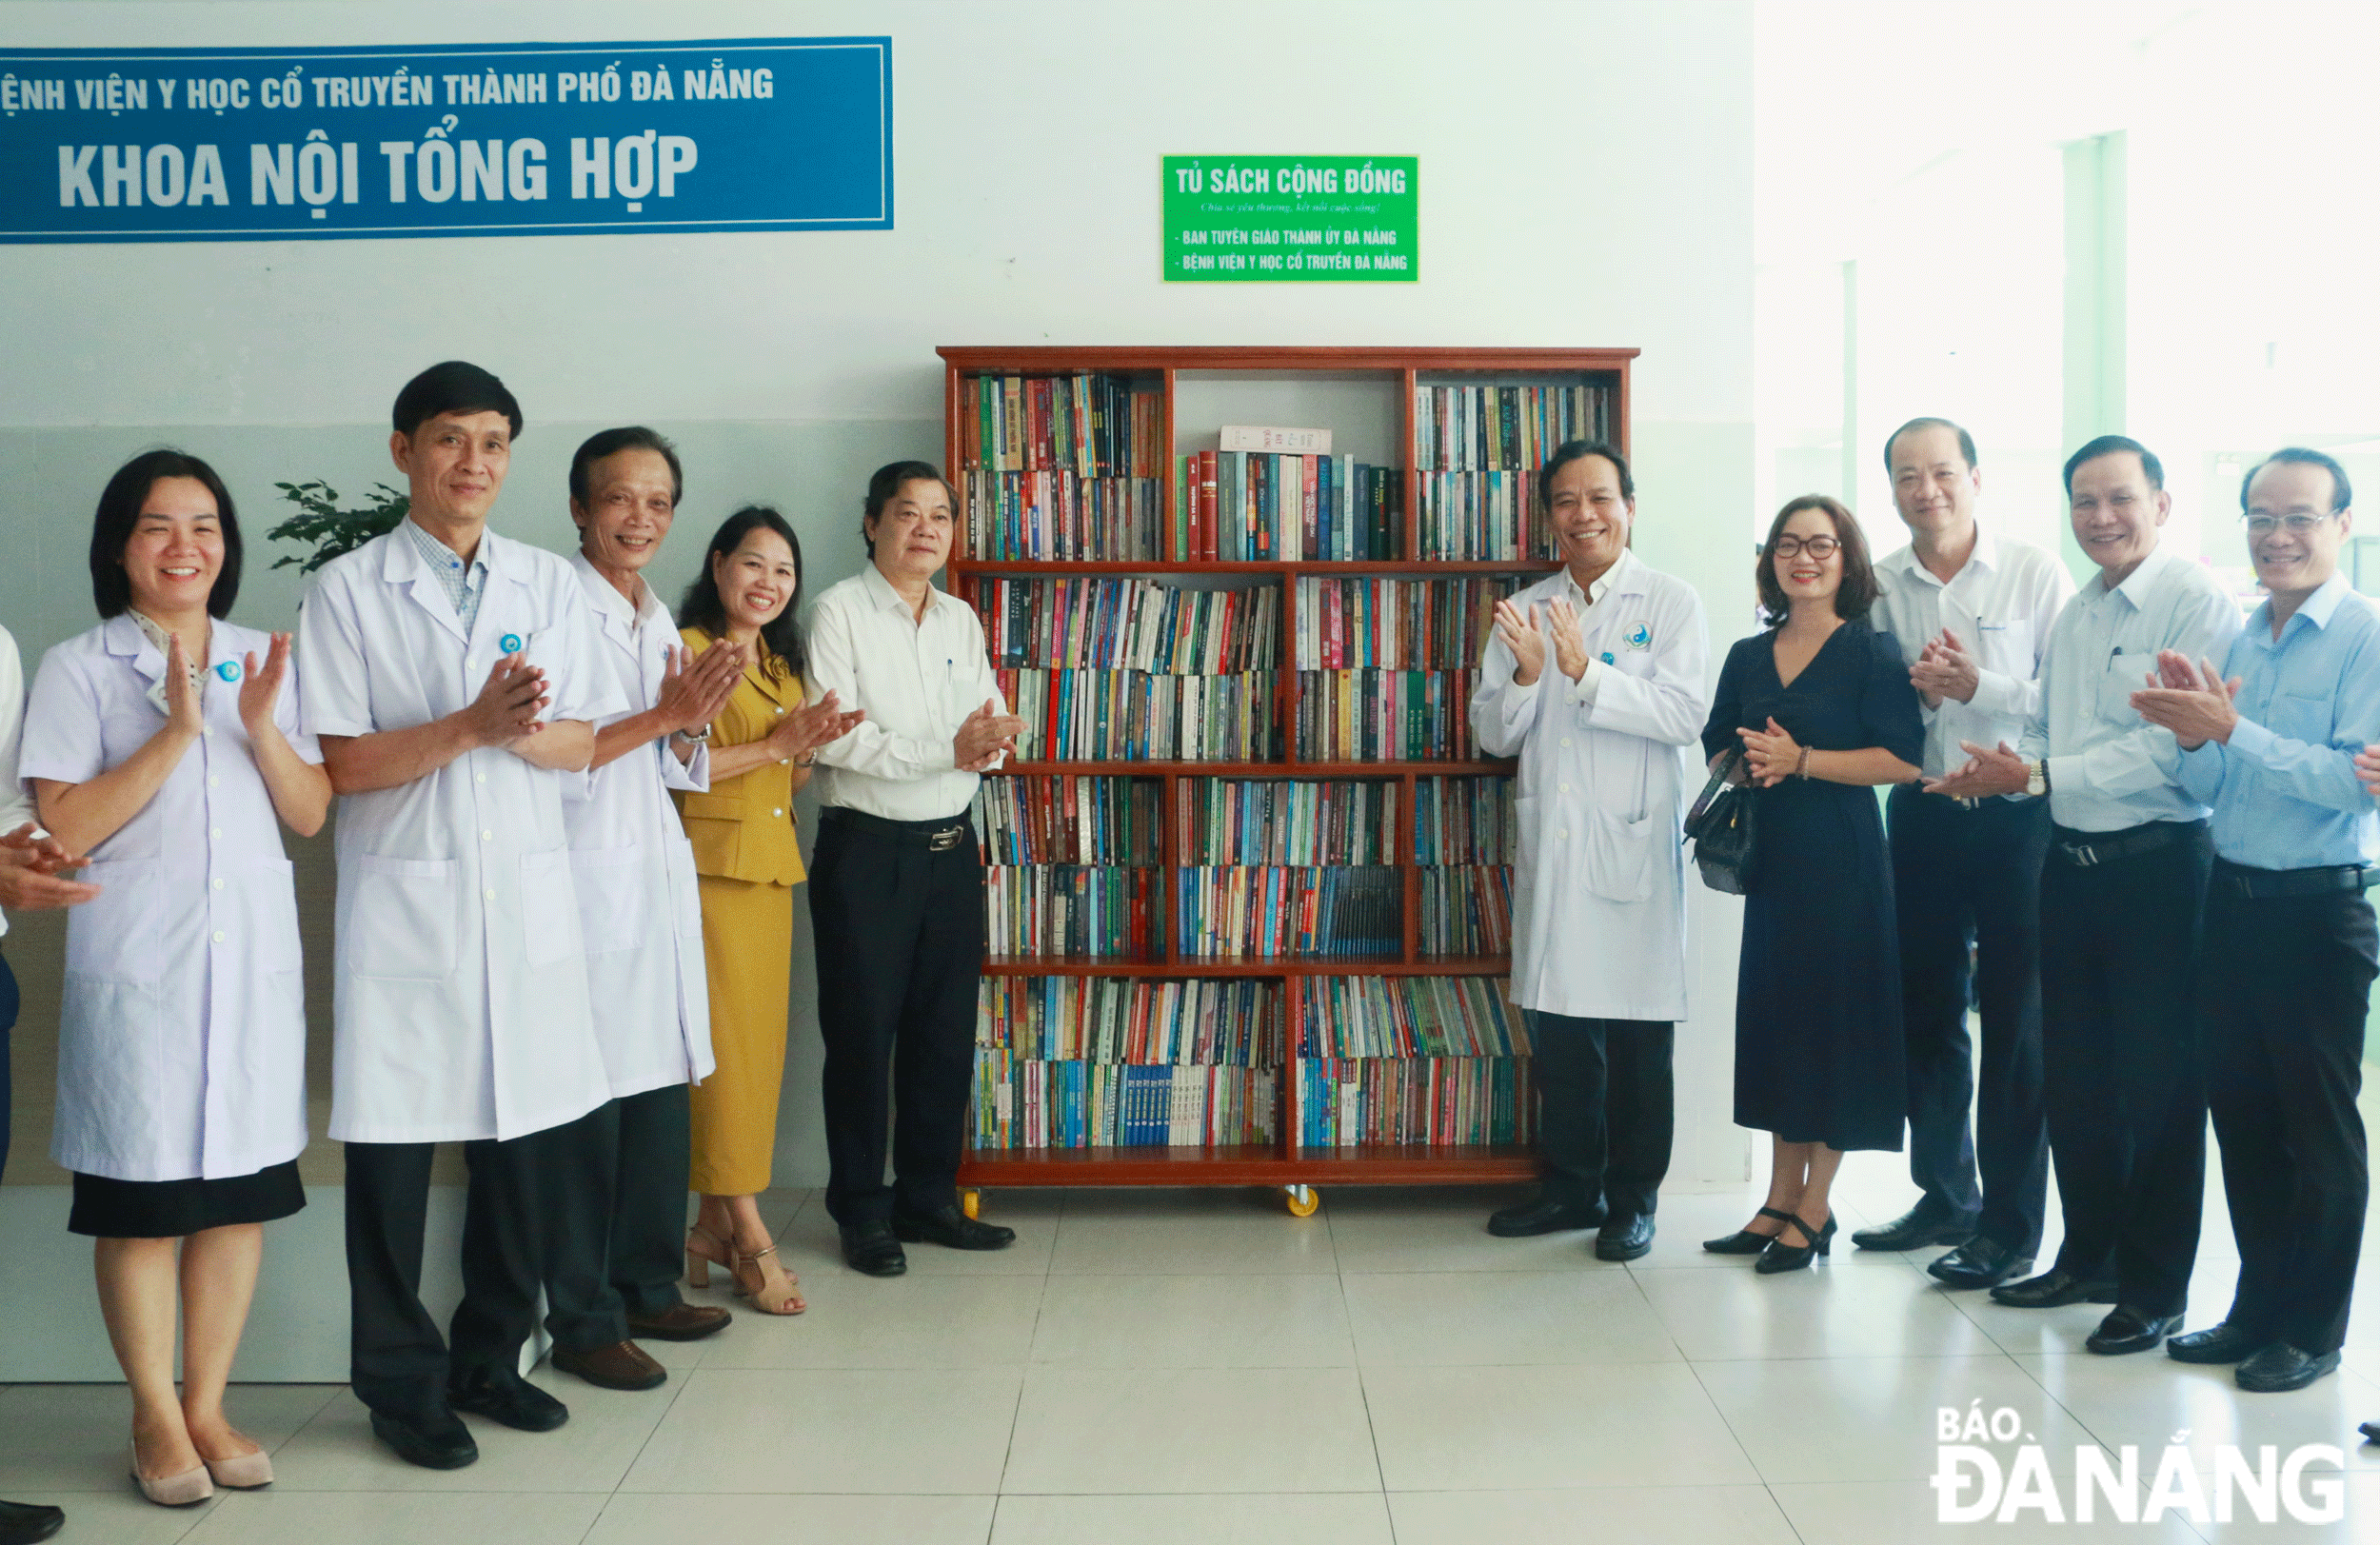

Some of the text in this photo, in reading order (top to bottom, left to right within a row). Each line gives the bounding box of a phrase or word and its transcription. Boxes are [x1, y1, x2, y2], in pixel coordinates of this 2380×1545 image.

[75, 72, 148, 116] VIỆN
[157, 79, 176, 109] Y
[188, 78, 250, 115] HỌC
[261, 66, 303, 109] CỔ
[312, 66, 432, 108] TRUYỀN
[443, 68, 546, 107] THÀNH
[558, 61, 621, 103] PHỐ
[631, 64, 674, 102] ĐÀ
[684, 58, 773, 100] NẴNG
[58, 114, 698, 219] KHOA NỘI TỔNG HỢP
[1176, 160, 1406, 199] TỦ SÁCH CỘNG ĐỒNG
[1182, 230, 1207, 245] BAN
[1211, 227, 1248, 245] TUYÊN
[1252, 227, 1279, 245] GIÁO
[1282, 227, 1322, 245] THÀNH
[1343, 227, 1359, 245] ĐÀ
[1182, 252, 1215, 273] BỆNH
[1218, 251, 1245, 273] VIỆN
[1249, 255, 1256, 269] Y
[1259, 254, 1282, 273] HỌC
[1287, 248, 1303, 269] CỔ
[1306, 250, 1352, 269] TRUYỀN
[1354, 251, 1371, 269] ĐÀ
